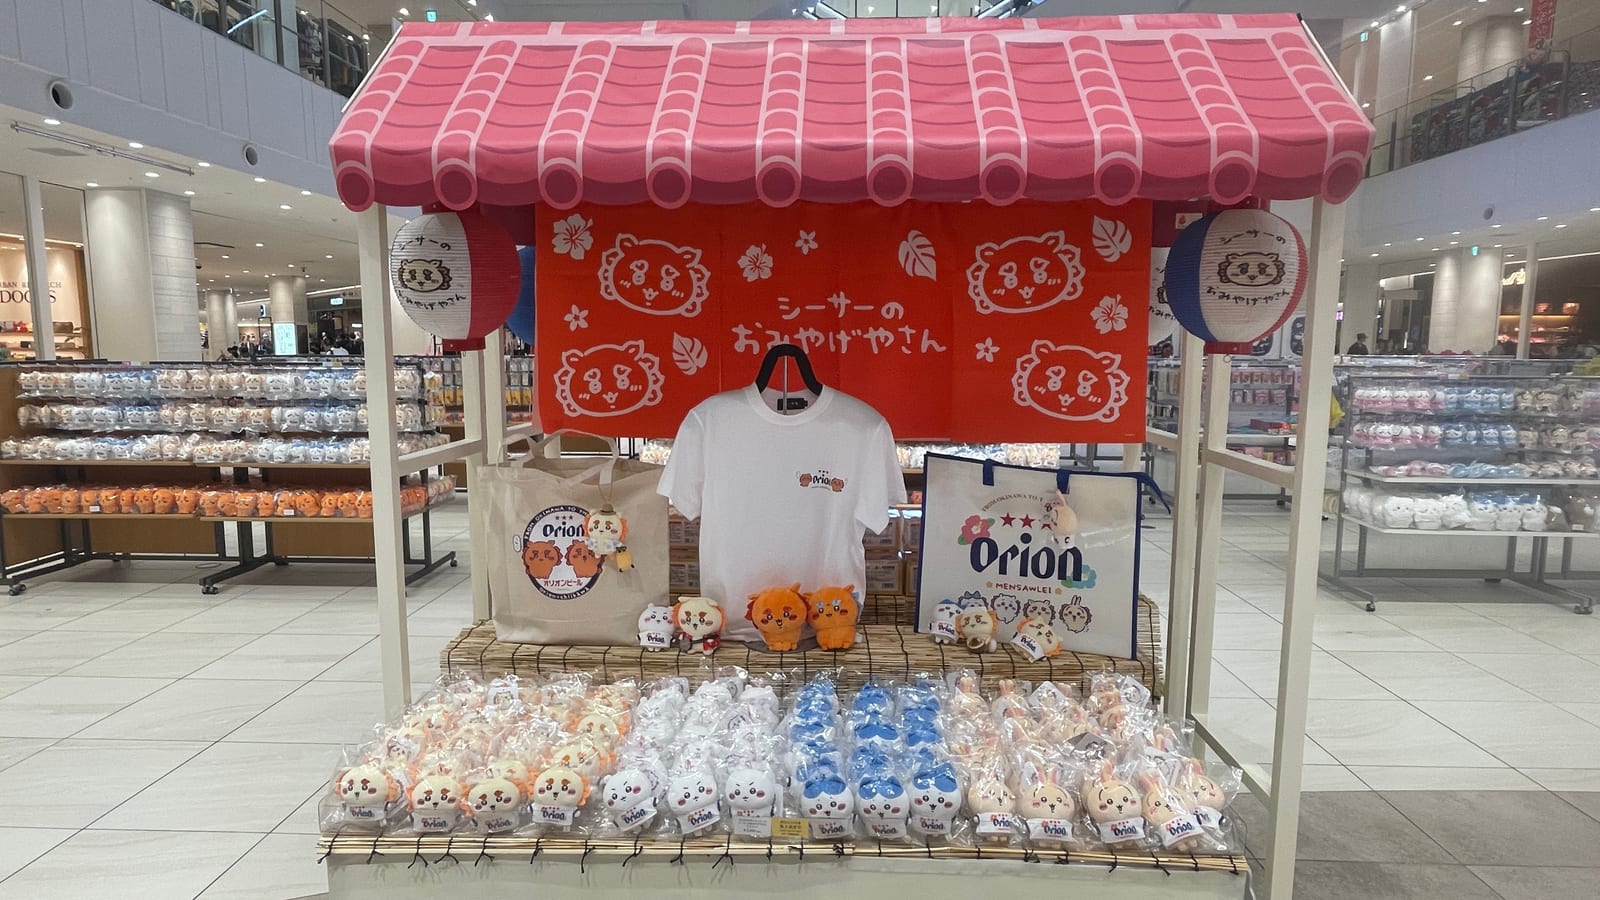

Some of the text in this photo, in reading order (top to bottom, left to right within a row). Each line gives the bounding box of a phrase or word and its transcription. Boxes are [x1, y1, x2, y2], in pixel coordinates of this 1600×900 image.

[1220, 229, 1286, 244] シーサーの
[0, 290, 57, 304] DOS
[1206, 285, 1289, 306] おみやげやさん
[777, 291, 904, 320] シーサーの
[731, 322, 947, 354] おみやげやさん
[542, 521, 585, 538] Orion
[970, 532, 1083, 583] Orion
[543, 578, 584, 588] オリオンビール
[542, 810, 565, 821] Orion
[623, 808, 646, 825] Orion
[690, 811, 713, 826] Orion
[1044, 824, 1067, 836] Orion
[1113, 825, 1138, 837] Orion
[1169, 822, 1194, 836] Orion
